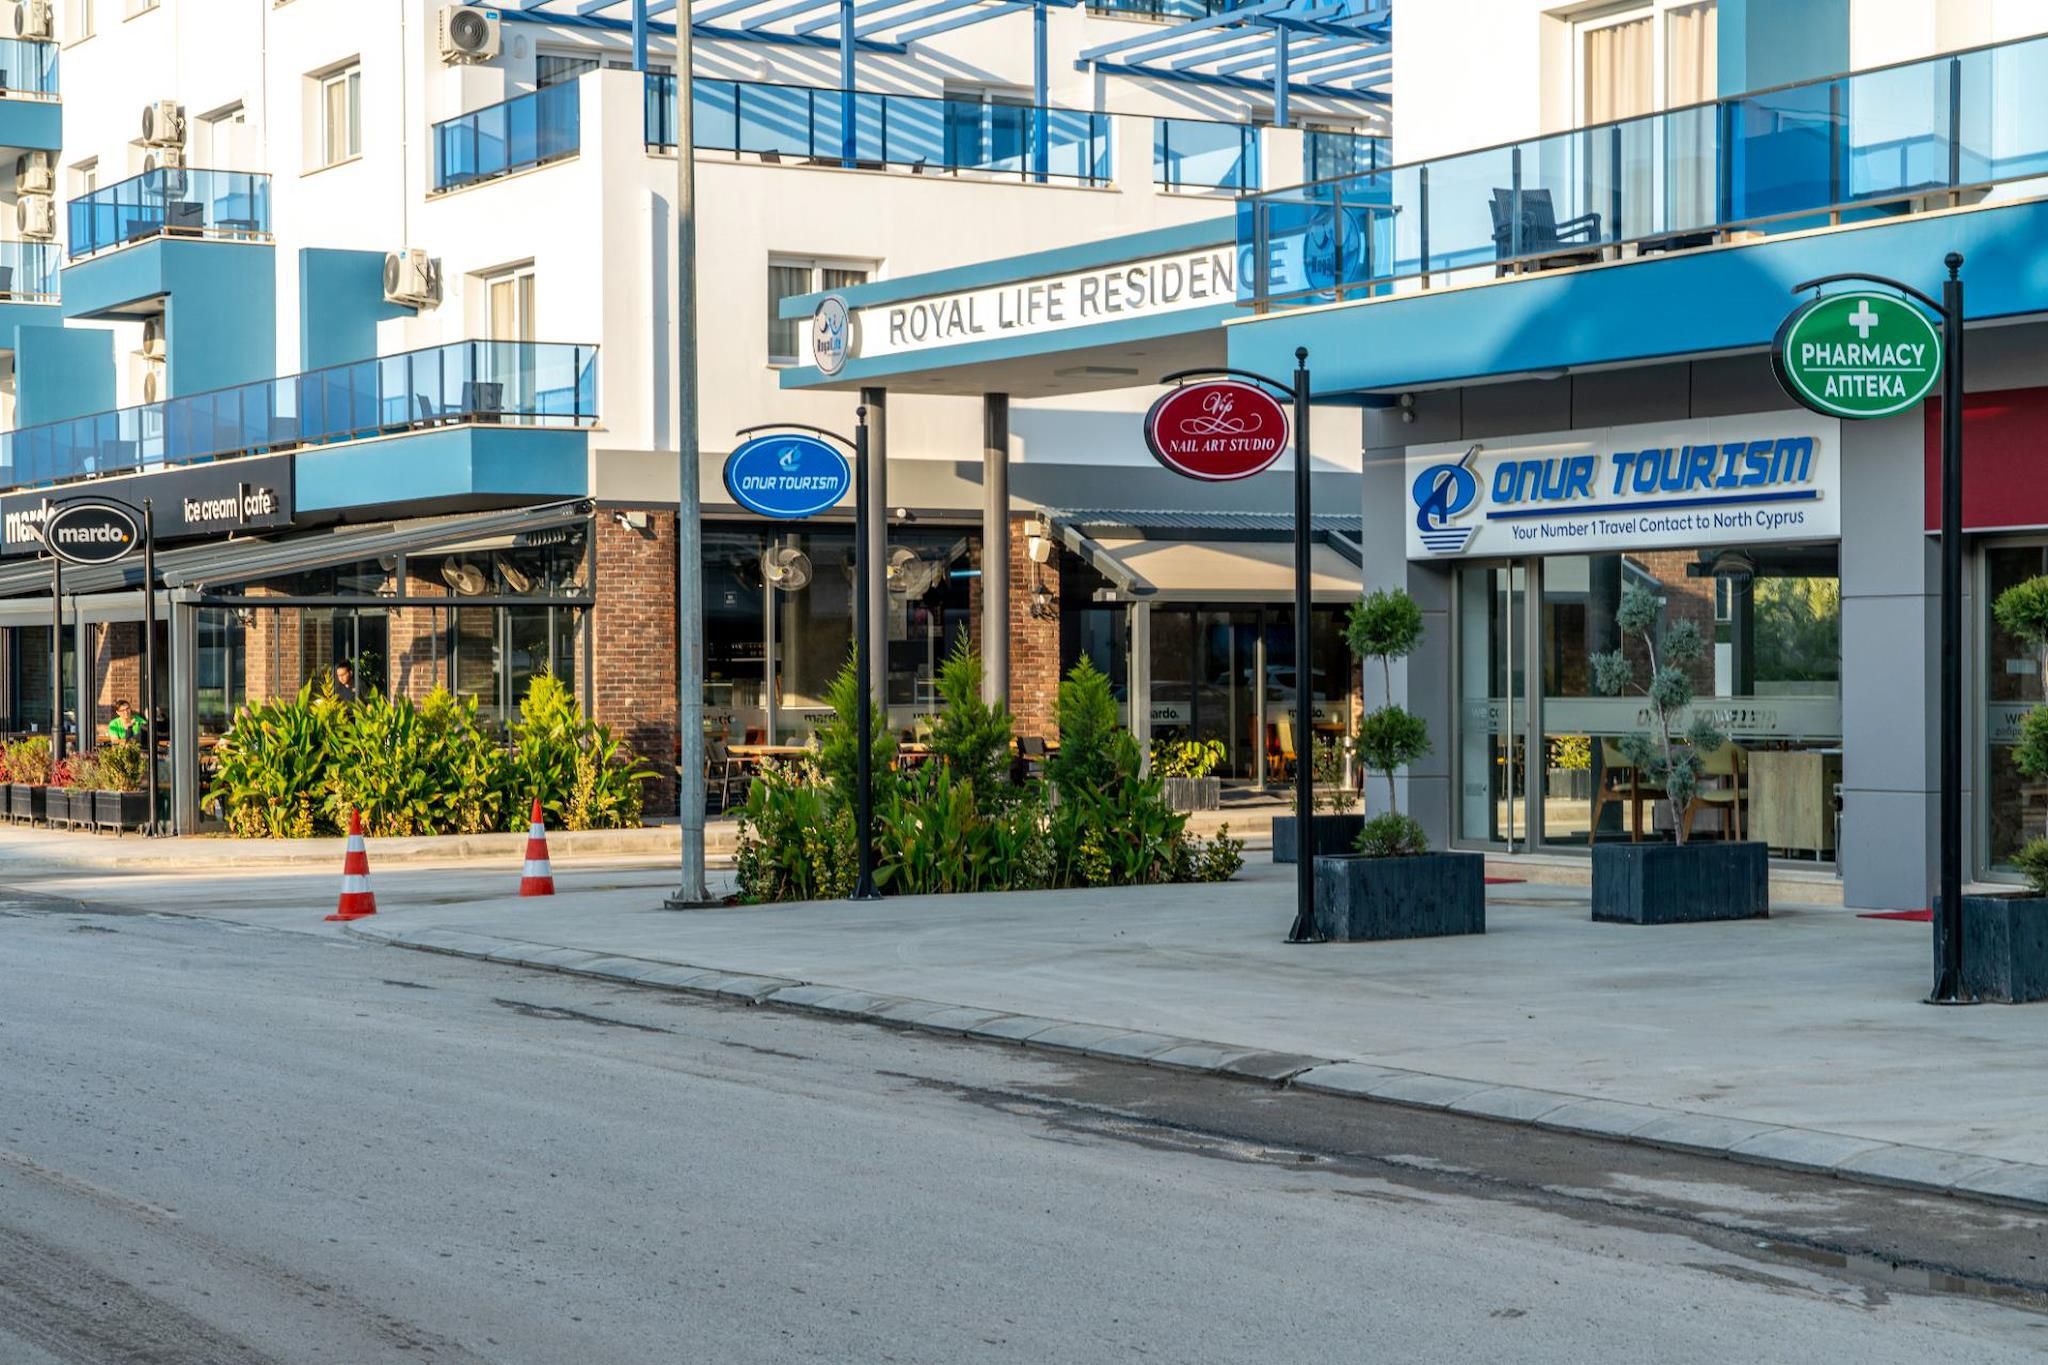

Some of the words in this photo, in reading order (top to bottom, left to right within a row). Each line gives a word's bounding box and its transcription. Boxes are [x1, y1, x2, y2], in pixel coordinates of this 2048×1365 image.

[888, 296, 985, 346] ROYAL
[997, 281, 1066, 329] LIFE
[1079, 240, 1288, 318] RESIDENCE
[1802, 343, 1925, 366] PHARMACY
[1824, 375, 1906, 398] АПТЕКА
[1169, 439, 1199, 453] NAIL
[1201, 439, 1227, 452] ART
[1229, 437, 1276, 451] STUDIO
[1491, 454, 1599, 504] ONUR
[1612, 436, 1819, 496] TOURISM
[742, 476, 777, 490] ONUR
[778, 476, 839, 490] TOURISM
[184, 498, 200, 523] ice
[202, 497, 238, 521] cream
[244, 487, 272, 516] cafe
[58, 523, 129, 543] mardo.
[1512, 525, 1538, 541] Your
[1540, 521, 1589, 539] Number
[1591, 522, 1597, 536] 1
[1599, 519, 1637, 535] Travel
[1639, 517, 1693, 533] Contact
[1696, 516, 1710, 530] to
[1713, 511, 1753, 529] North
[1755, 510, 1805, 530] Cyprus
